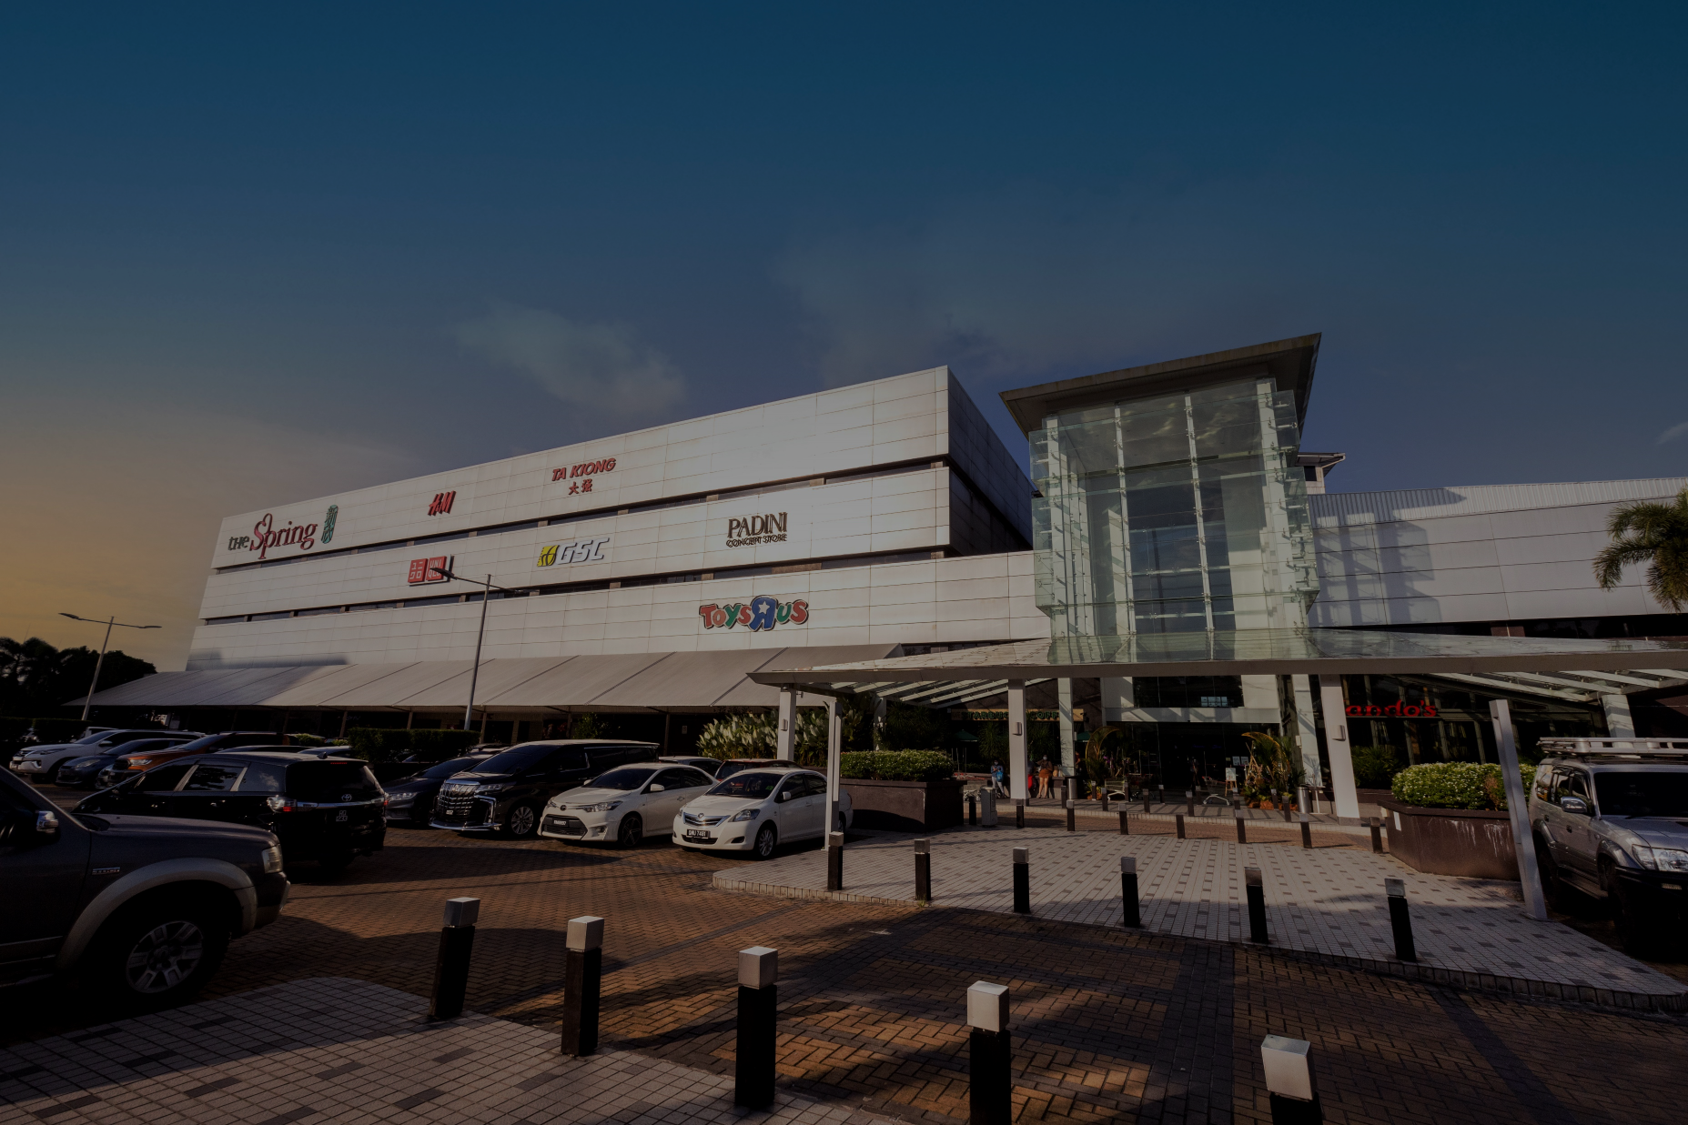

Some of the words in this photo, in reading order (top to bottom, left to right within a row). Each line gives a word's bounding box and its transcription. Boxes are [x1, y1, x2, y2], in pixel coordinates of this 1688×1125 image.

[551, 467, 567, 482] TA
[569, 457, 617, 478] KIONG
[427, 490, 457, 517] H&M
[249, 513, 318, 559] Spring
[727, 511, 788, 539] PADINI
[556, 537, 610, 565] GSC
[725, 536, 762, 548] CONCEPT
[762, 533, 788, 544] STORE
[961, 710, 1009, 720] STARBUC
[1344, 699, 1437, 717] ando's
